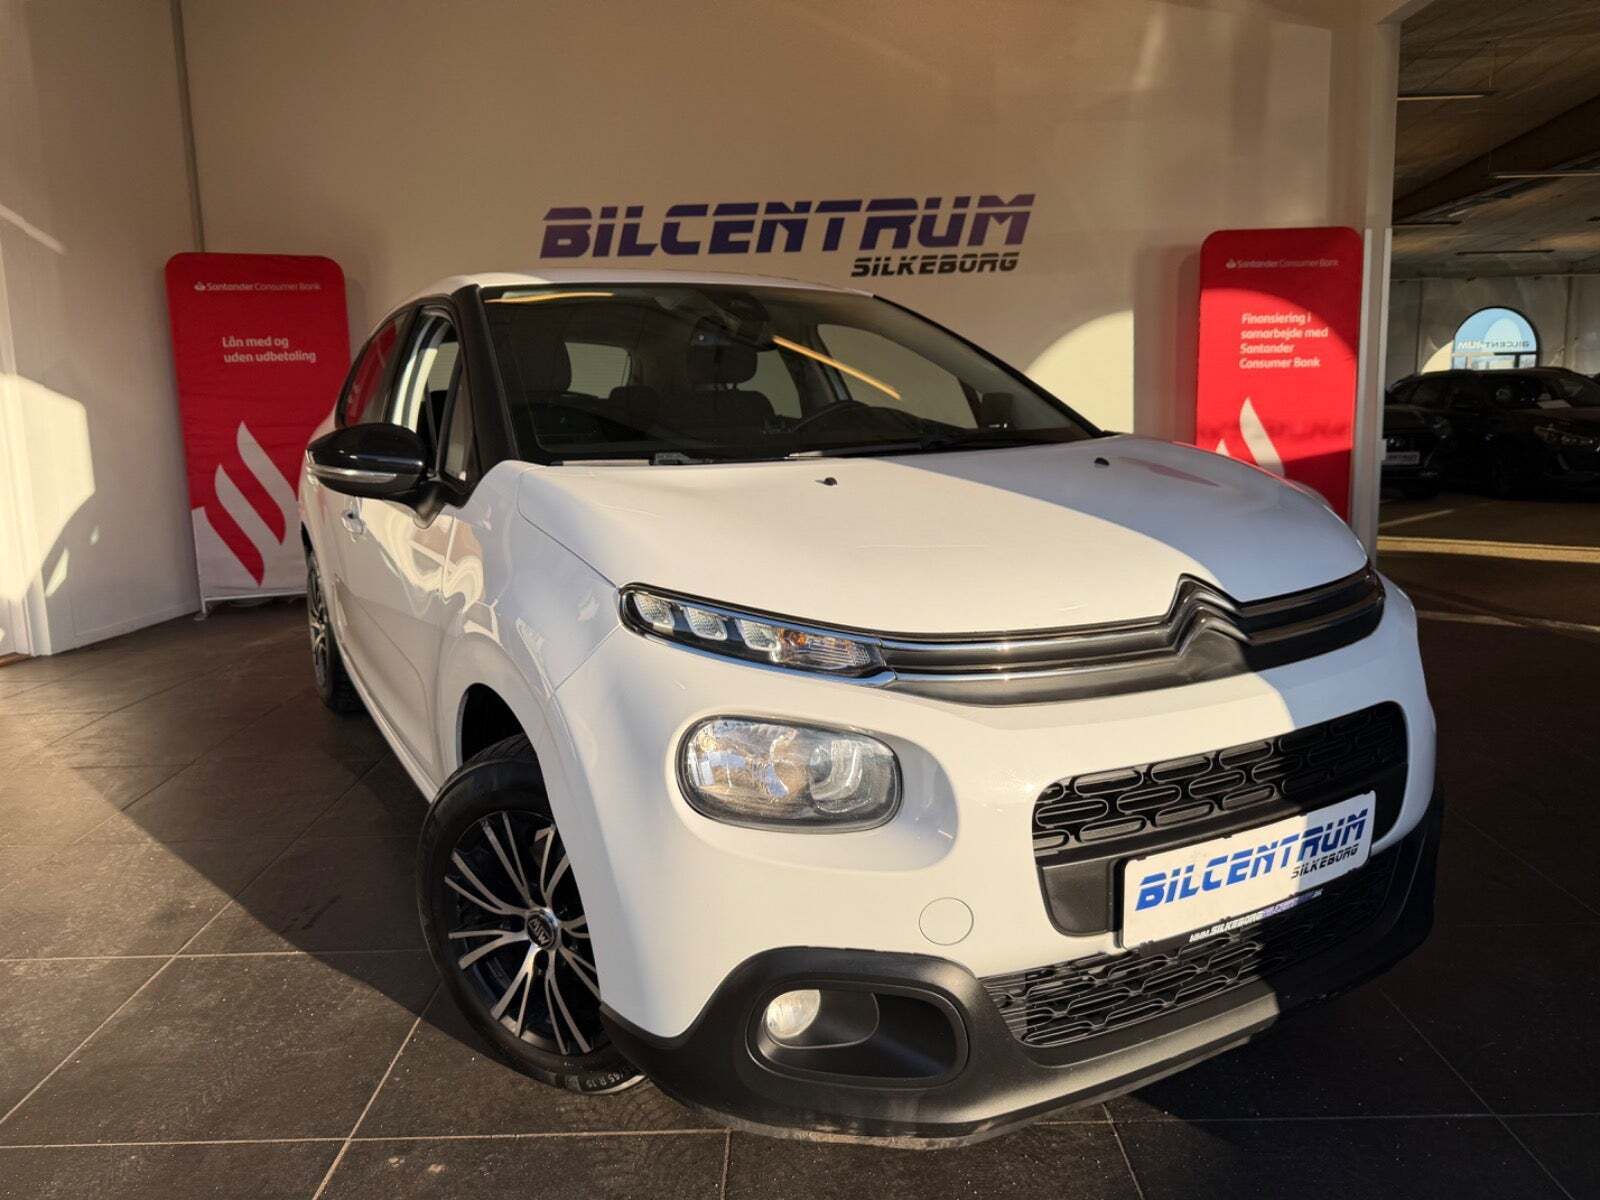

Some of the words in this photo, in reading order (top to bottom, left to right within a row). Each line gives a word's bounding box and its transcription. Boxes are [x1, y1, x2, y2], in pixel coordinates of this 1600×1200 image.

[539, 194, 1037, 259] BILCENTRUM
[851, 252, 1020, 278] SILKEBORG
[1237, 260, 1279, 269] Santander
[206, 282, 253, 292] Santander
[254, 282, 298, 292] Consumer
[299, 282, 321, 291] Bank
[1241, 313, 1306, 326] Finansiering
[1240, 329, 1303, 341] samarbejde
[1304, 327, 1329, 338] med
[222, 336, 244, 348] Lån
[245, 336, 272, 347] med
[274, 338, 289, 349] og
[1240, 343, 1296, 355] Santander
[224, 352, 254, 363] uden
[255, 350, 317, 364] udbetaling
[1239, 357, 1292, 369] Consumer
[1293, 356, 1321, 368] Bank
[1135, 808, 1369, 911] BILCENTRUM
[1290, 843, 1361, 880] SILKEBORG
